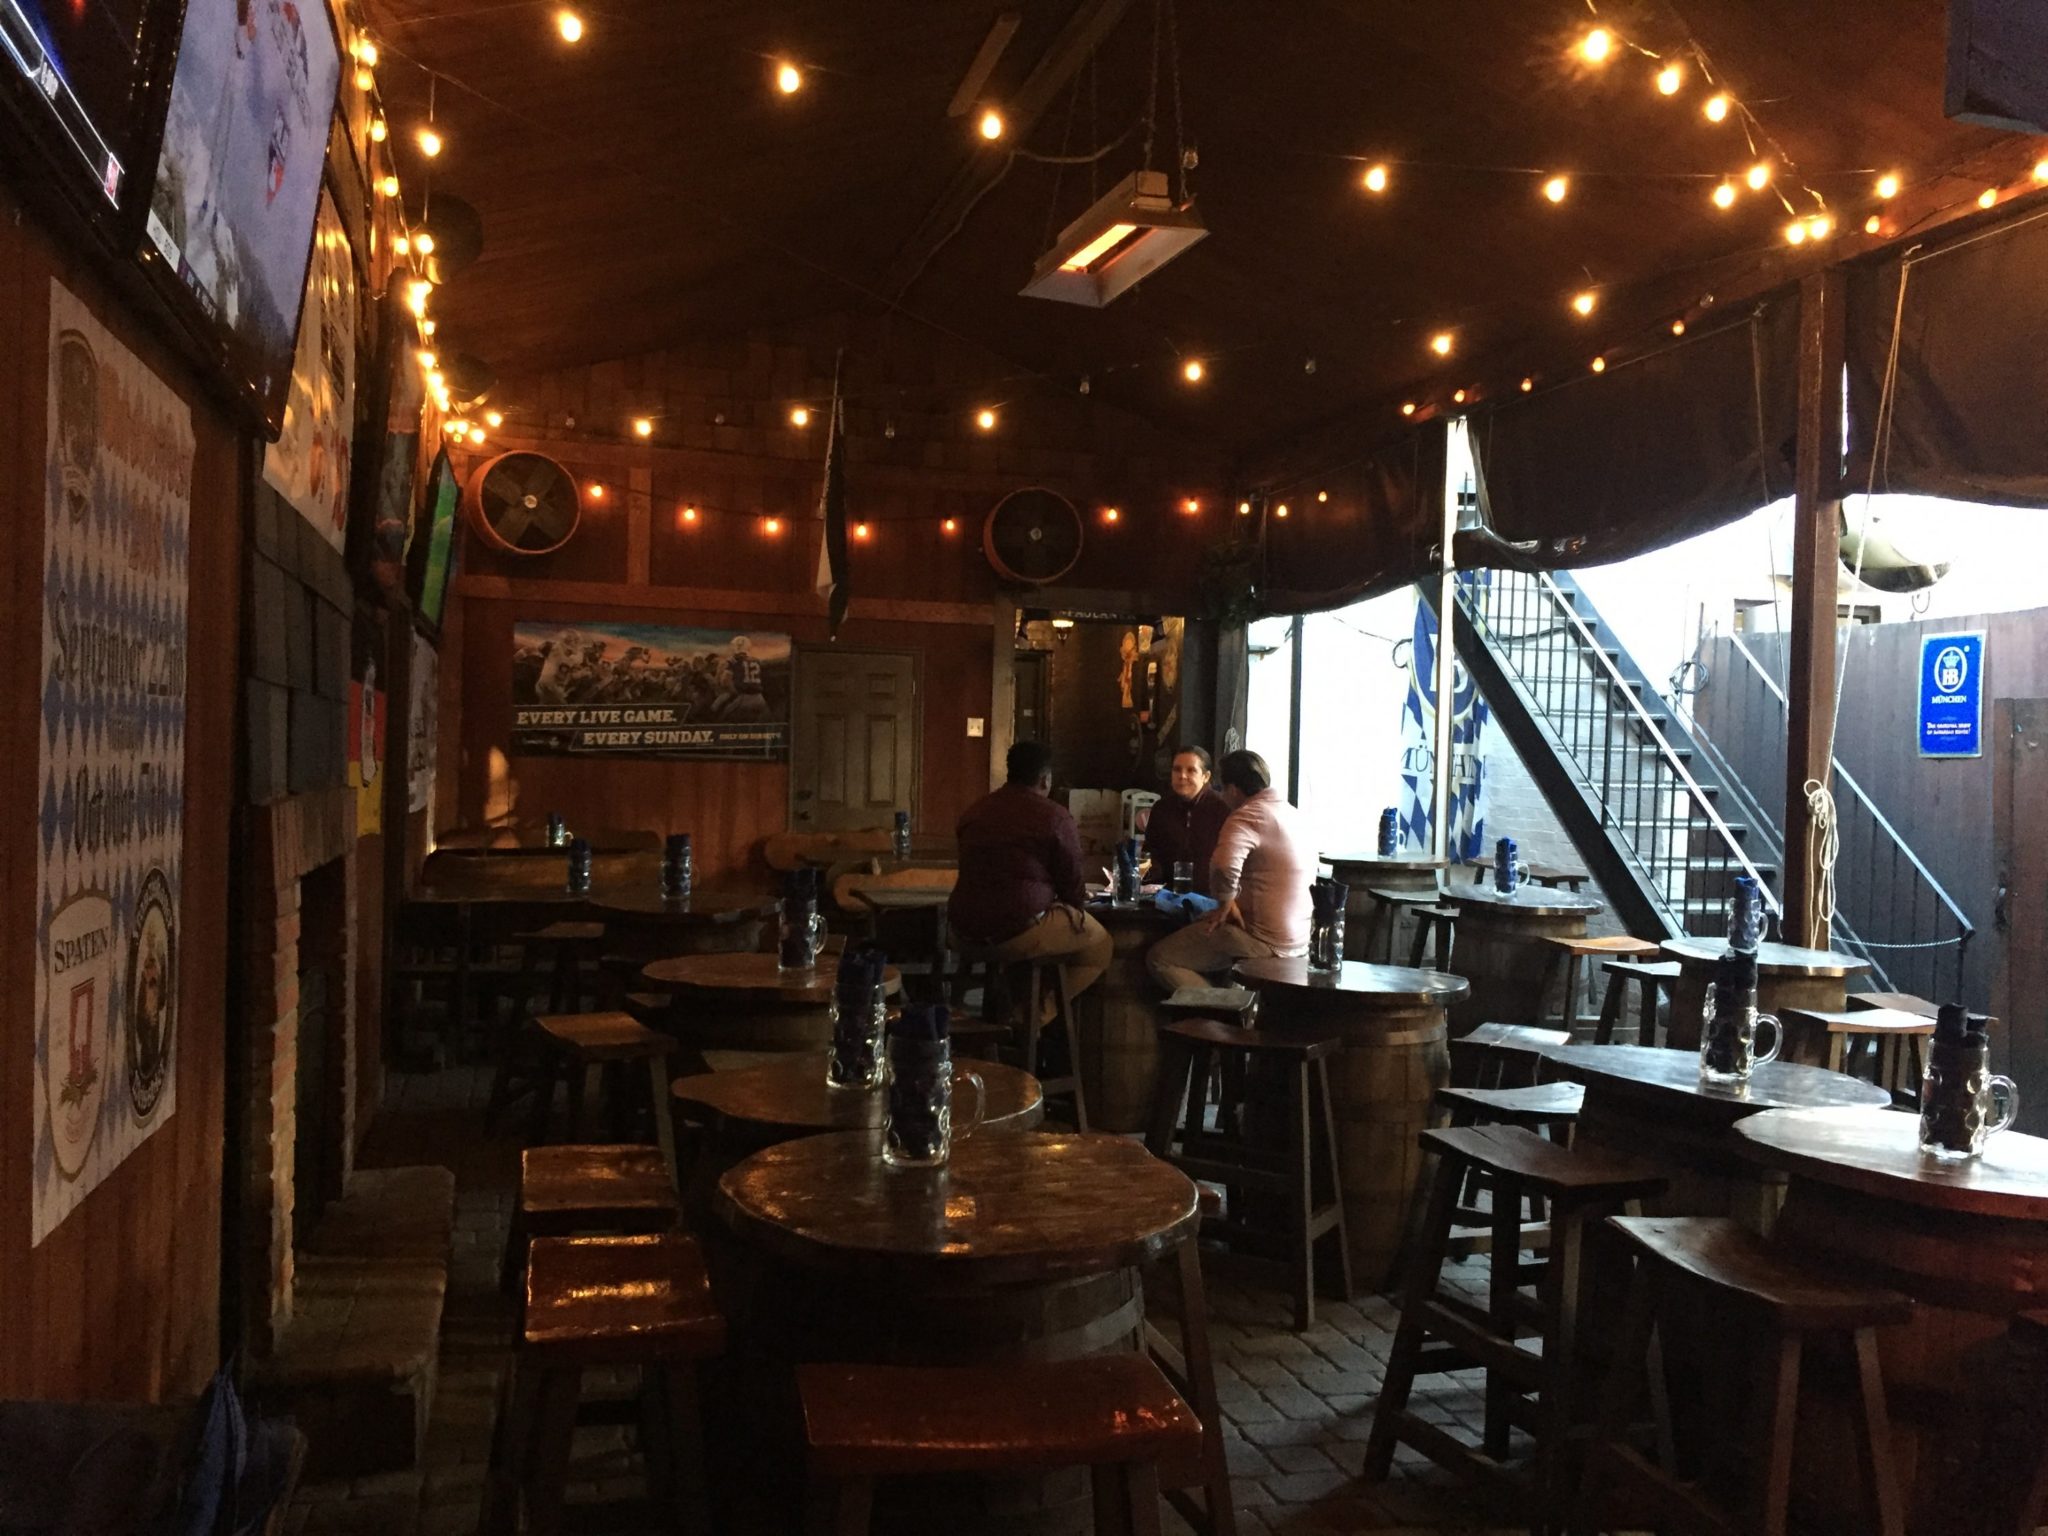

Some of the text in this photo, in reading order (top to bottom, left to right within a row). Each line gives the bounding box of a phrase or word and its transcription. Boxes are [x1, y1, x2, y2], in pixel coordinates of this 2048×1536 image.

[742, 661, 761, 683] 12
[516, 709, 677, 725] EVERY LIVE GAME.
[582, 731, 642, 745] EVERY
[644, 730, 715, 744] SUNDAY.
[55, 926, 109, 975] SPATEN
